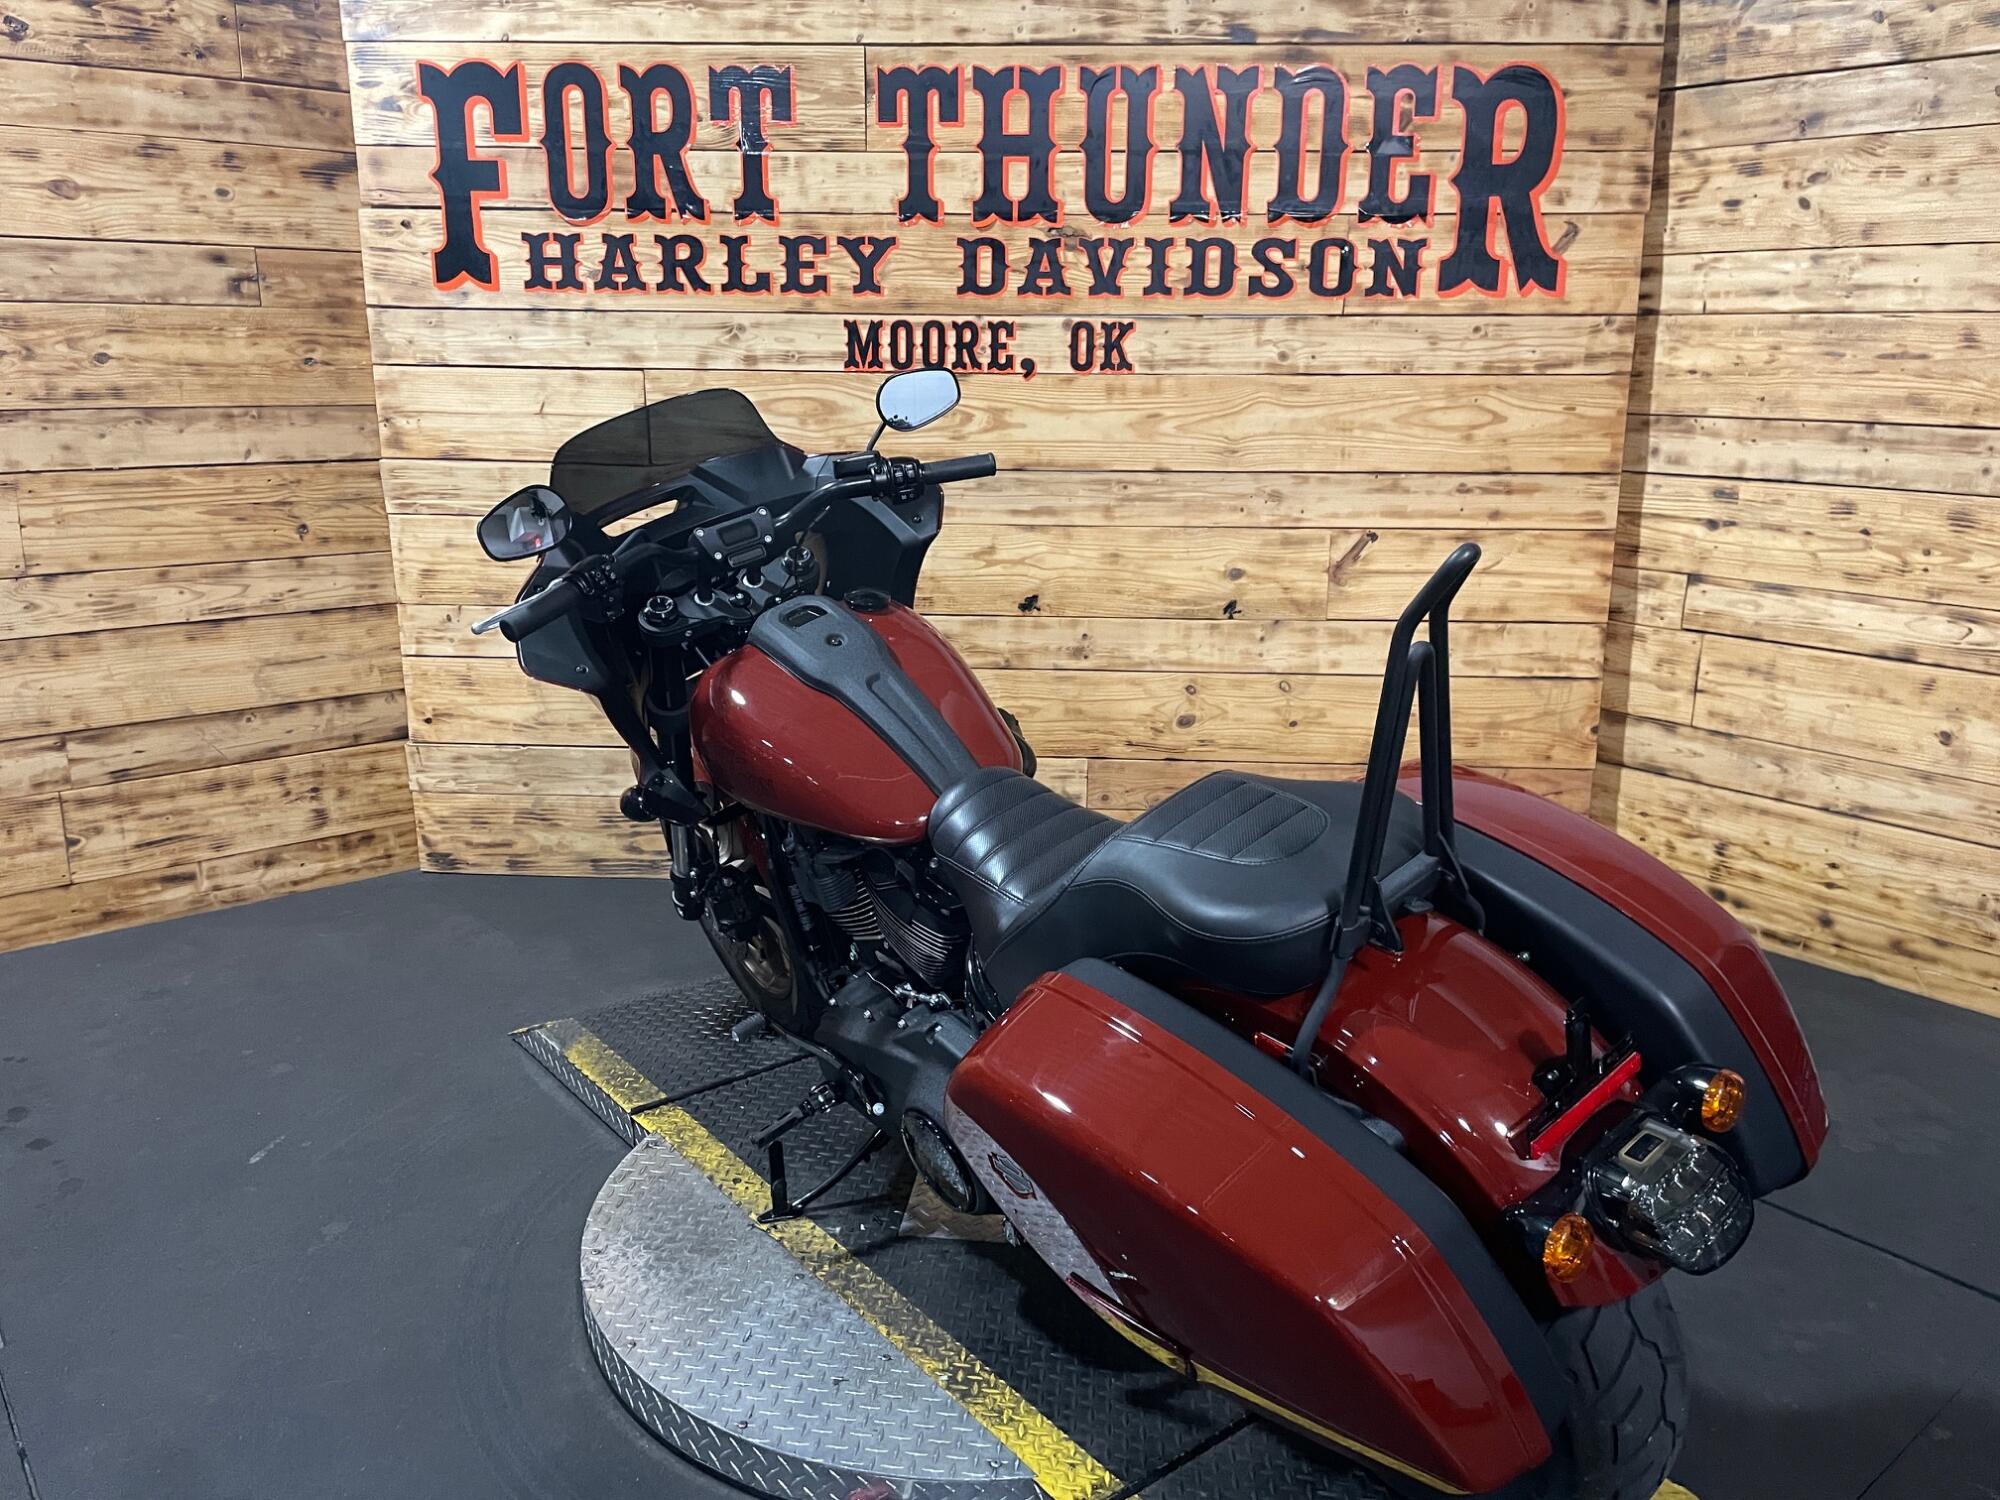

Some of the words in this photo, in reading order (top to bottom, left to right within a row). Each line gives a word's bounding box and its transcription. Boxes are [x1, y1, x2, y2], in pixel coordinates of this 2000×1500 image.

[417, 59, 795, 292] FORT
[876, 61, 1566, 299] THUNDER
[521, 232, 899, 295] HARLEY
[957, 236, 1428, 299] DAVIDSON
[845, 319, 1036, 379] MOORE,
[1068, 320, 1136, 375] OK
